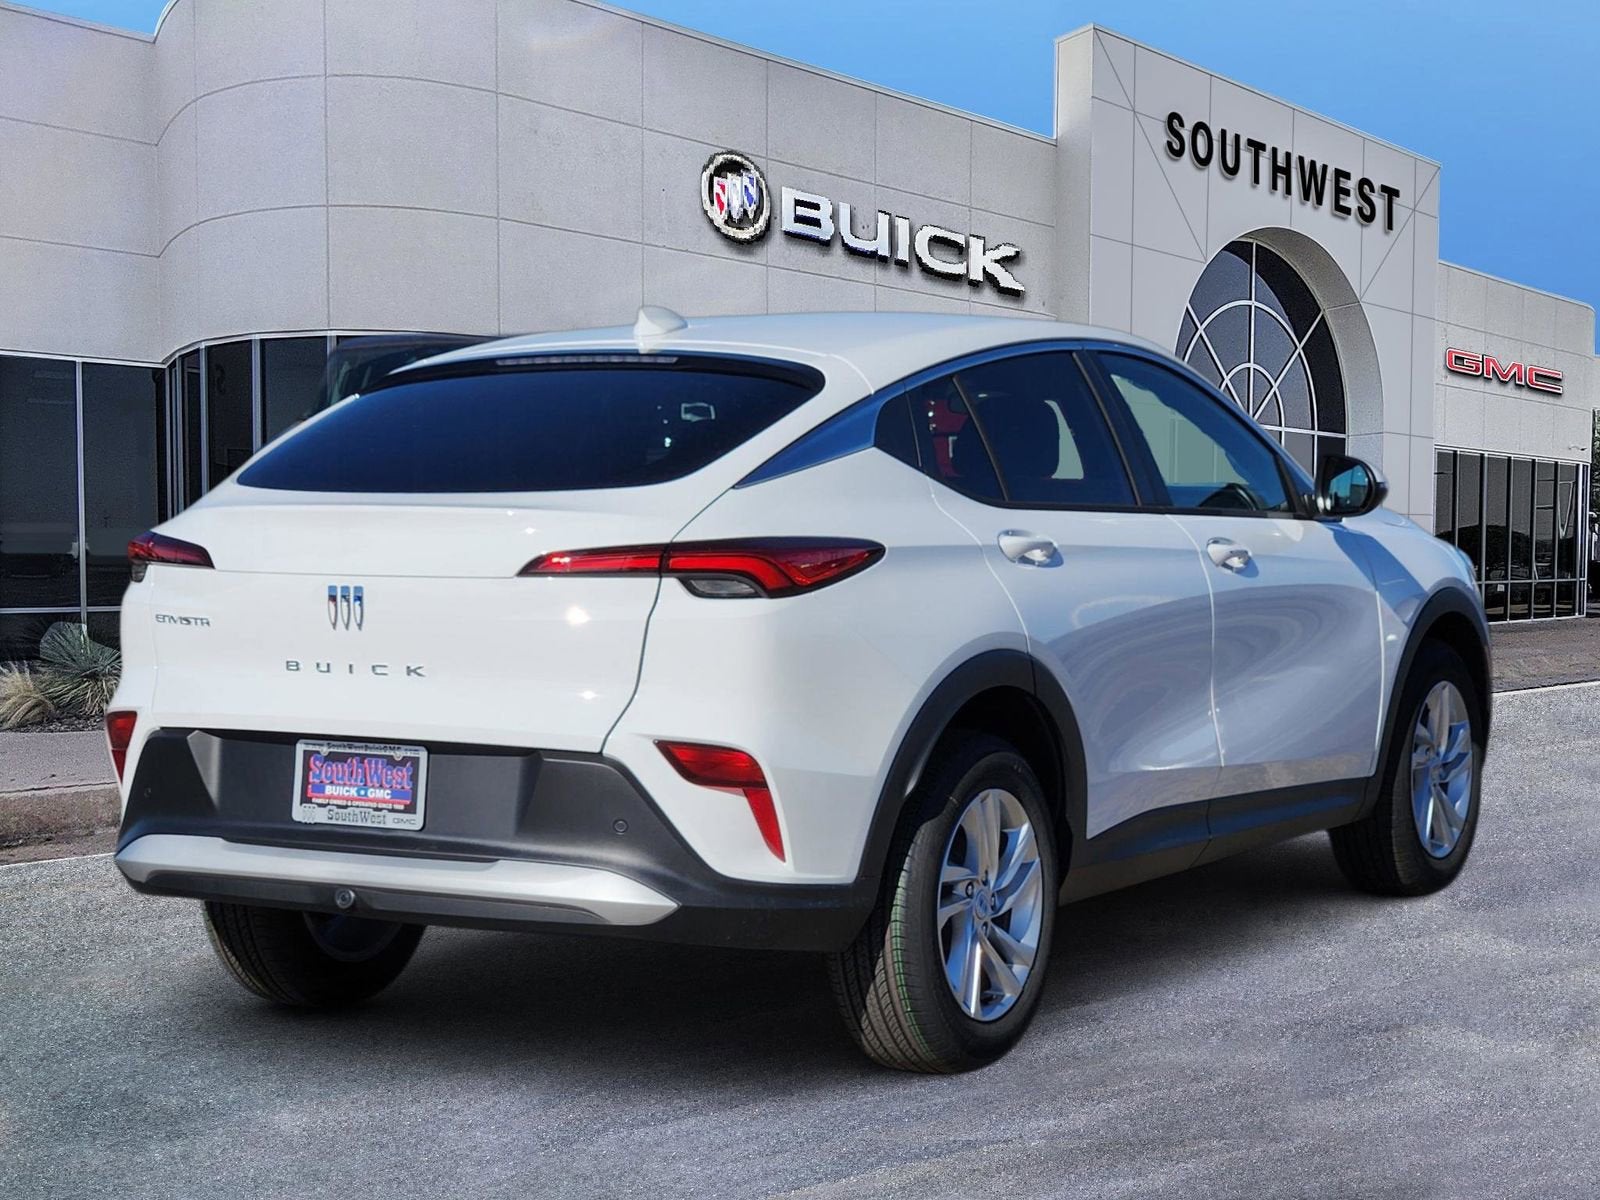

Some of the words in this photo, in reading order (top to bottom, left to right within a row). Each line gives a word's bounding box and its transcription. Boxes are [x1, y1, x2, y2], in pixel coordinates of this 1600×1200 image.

[1166, 111, 1400, 232] SOUTHWEST
[781, 186, 1025, 297] BUICK
[1446, 347, 1563, 395] GMC
[286, 660, 426, 677] BUICK
[308, 753, 413, 790] SouthWest
[325, 785, 358, 797] BUICK
[367, 787, 392, 799] GMC
[327, 809, 386, 825] SouthWest
